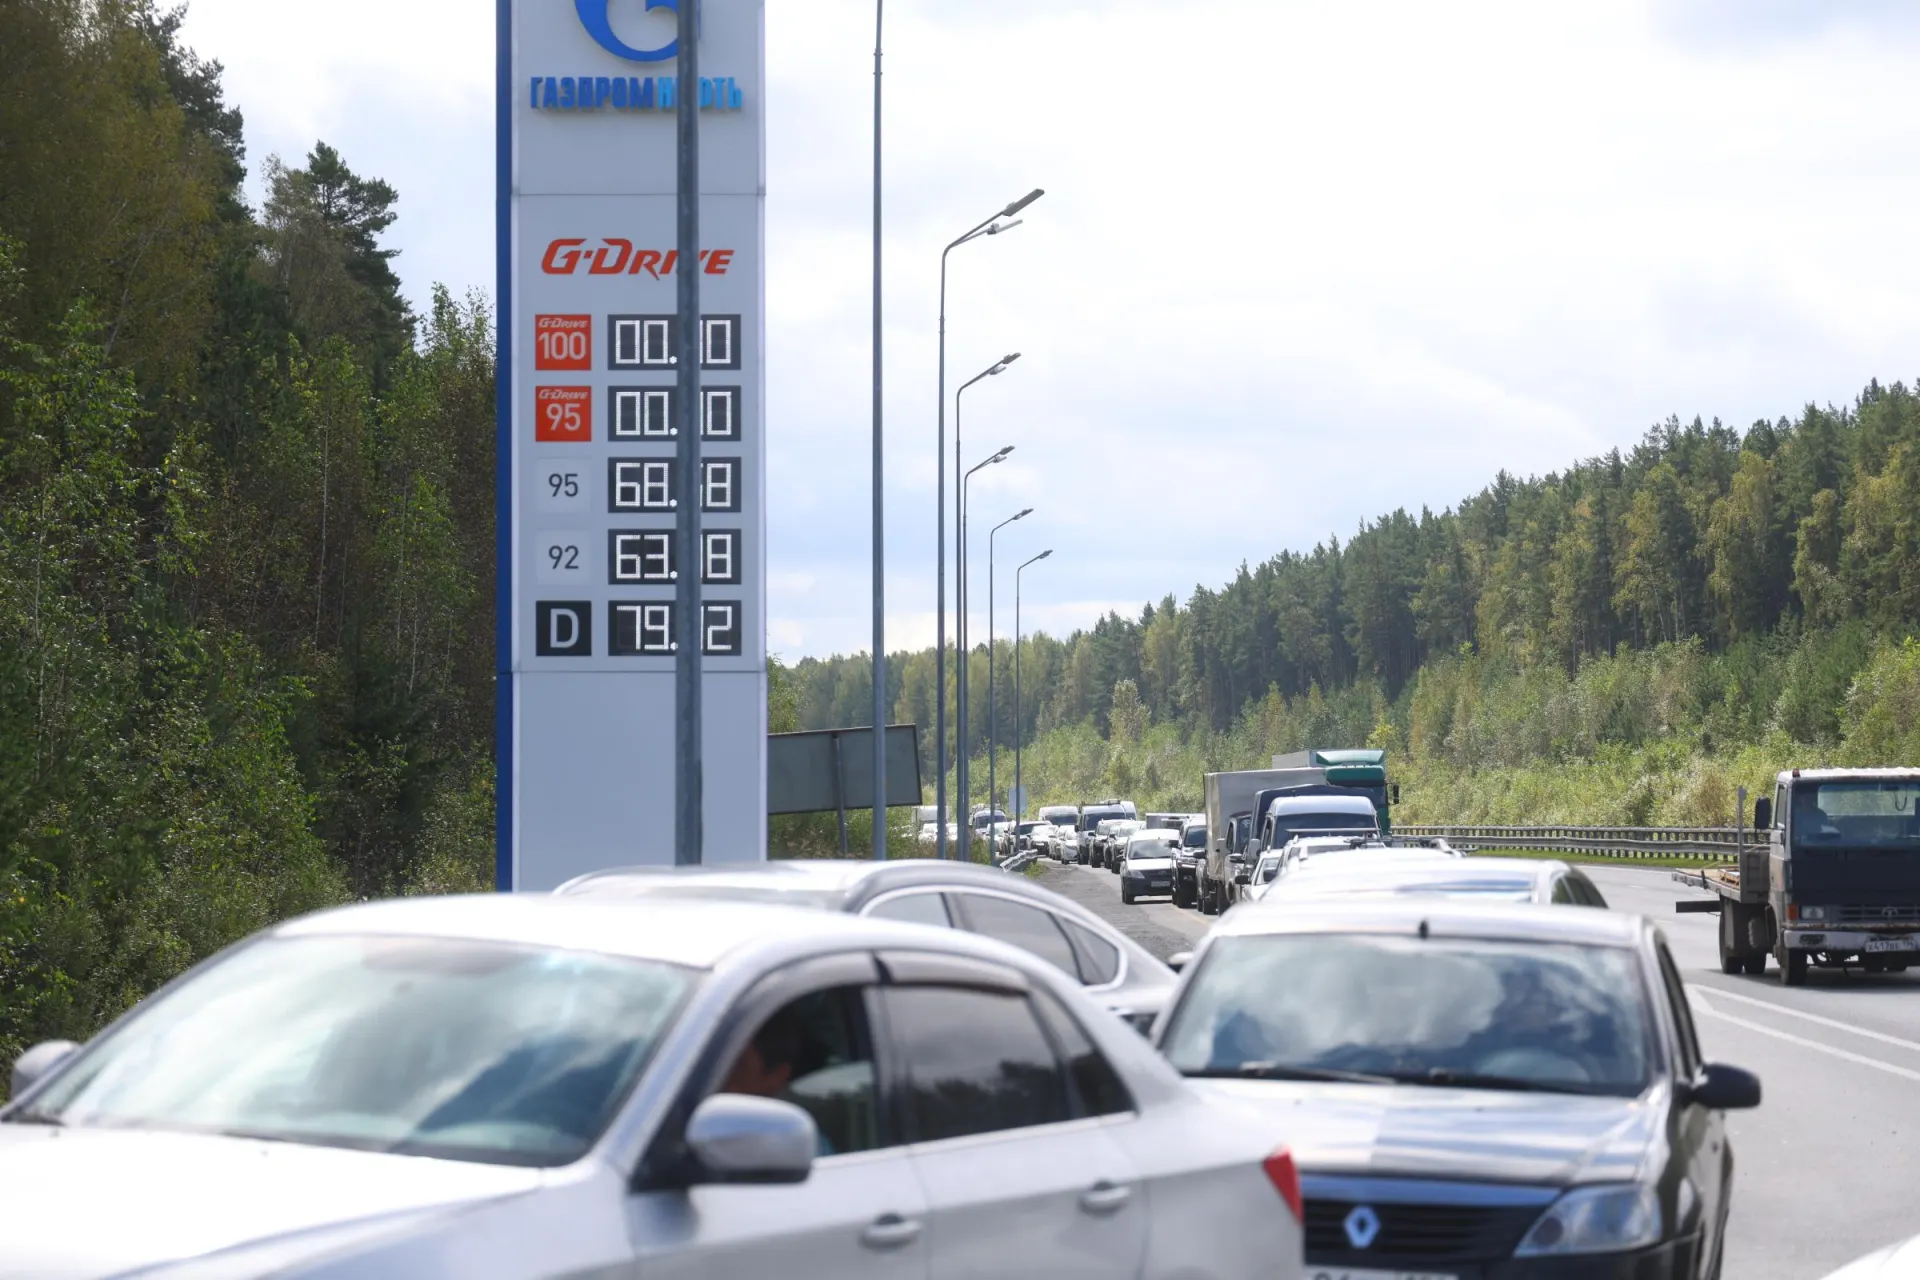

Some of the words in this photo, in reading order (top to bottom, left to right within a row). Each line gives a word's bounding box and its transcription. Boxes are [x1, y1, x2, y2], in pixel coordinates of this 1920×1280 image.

[530, 76, 743, 109] ГАЗПРОМНФТЬ
[538, 331, 586, 360] 100
[615, 319, 732, 365] 00.0
[546, 403, 581, 431] 95
[615, 391, 732, 436] 00.0
[548, 473, 579, 498] 95
[615, 462, 732, 507] 68.8
[548, 545, 579, 570] 92
[615, 534, 732, 579] 63.8
[549, 608, 580, 649] D
[616, 605, 732, 651] 79.2
